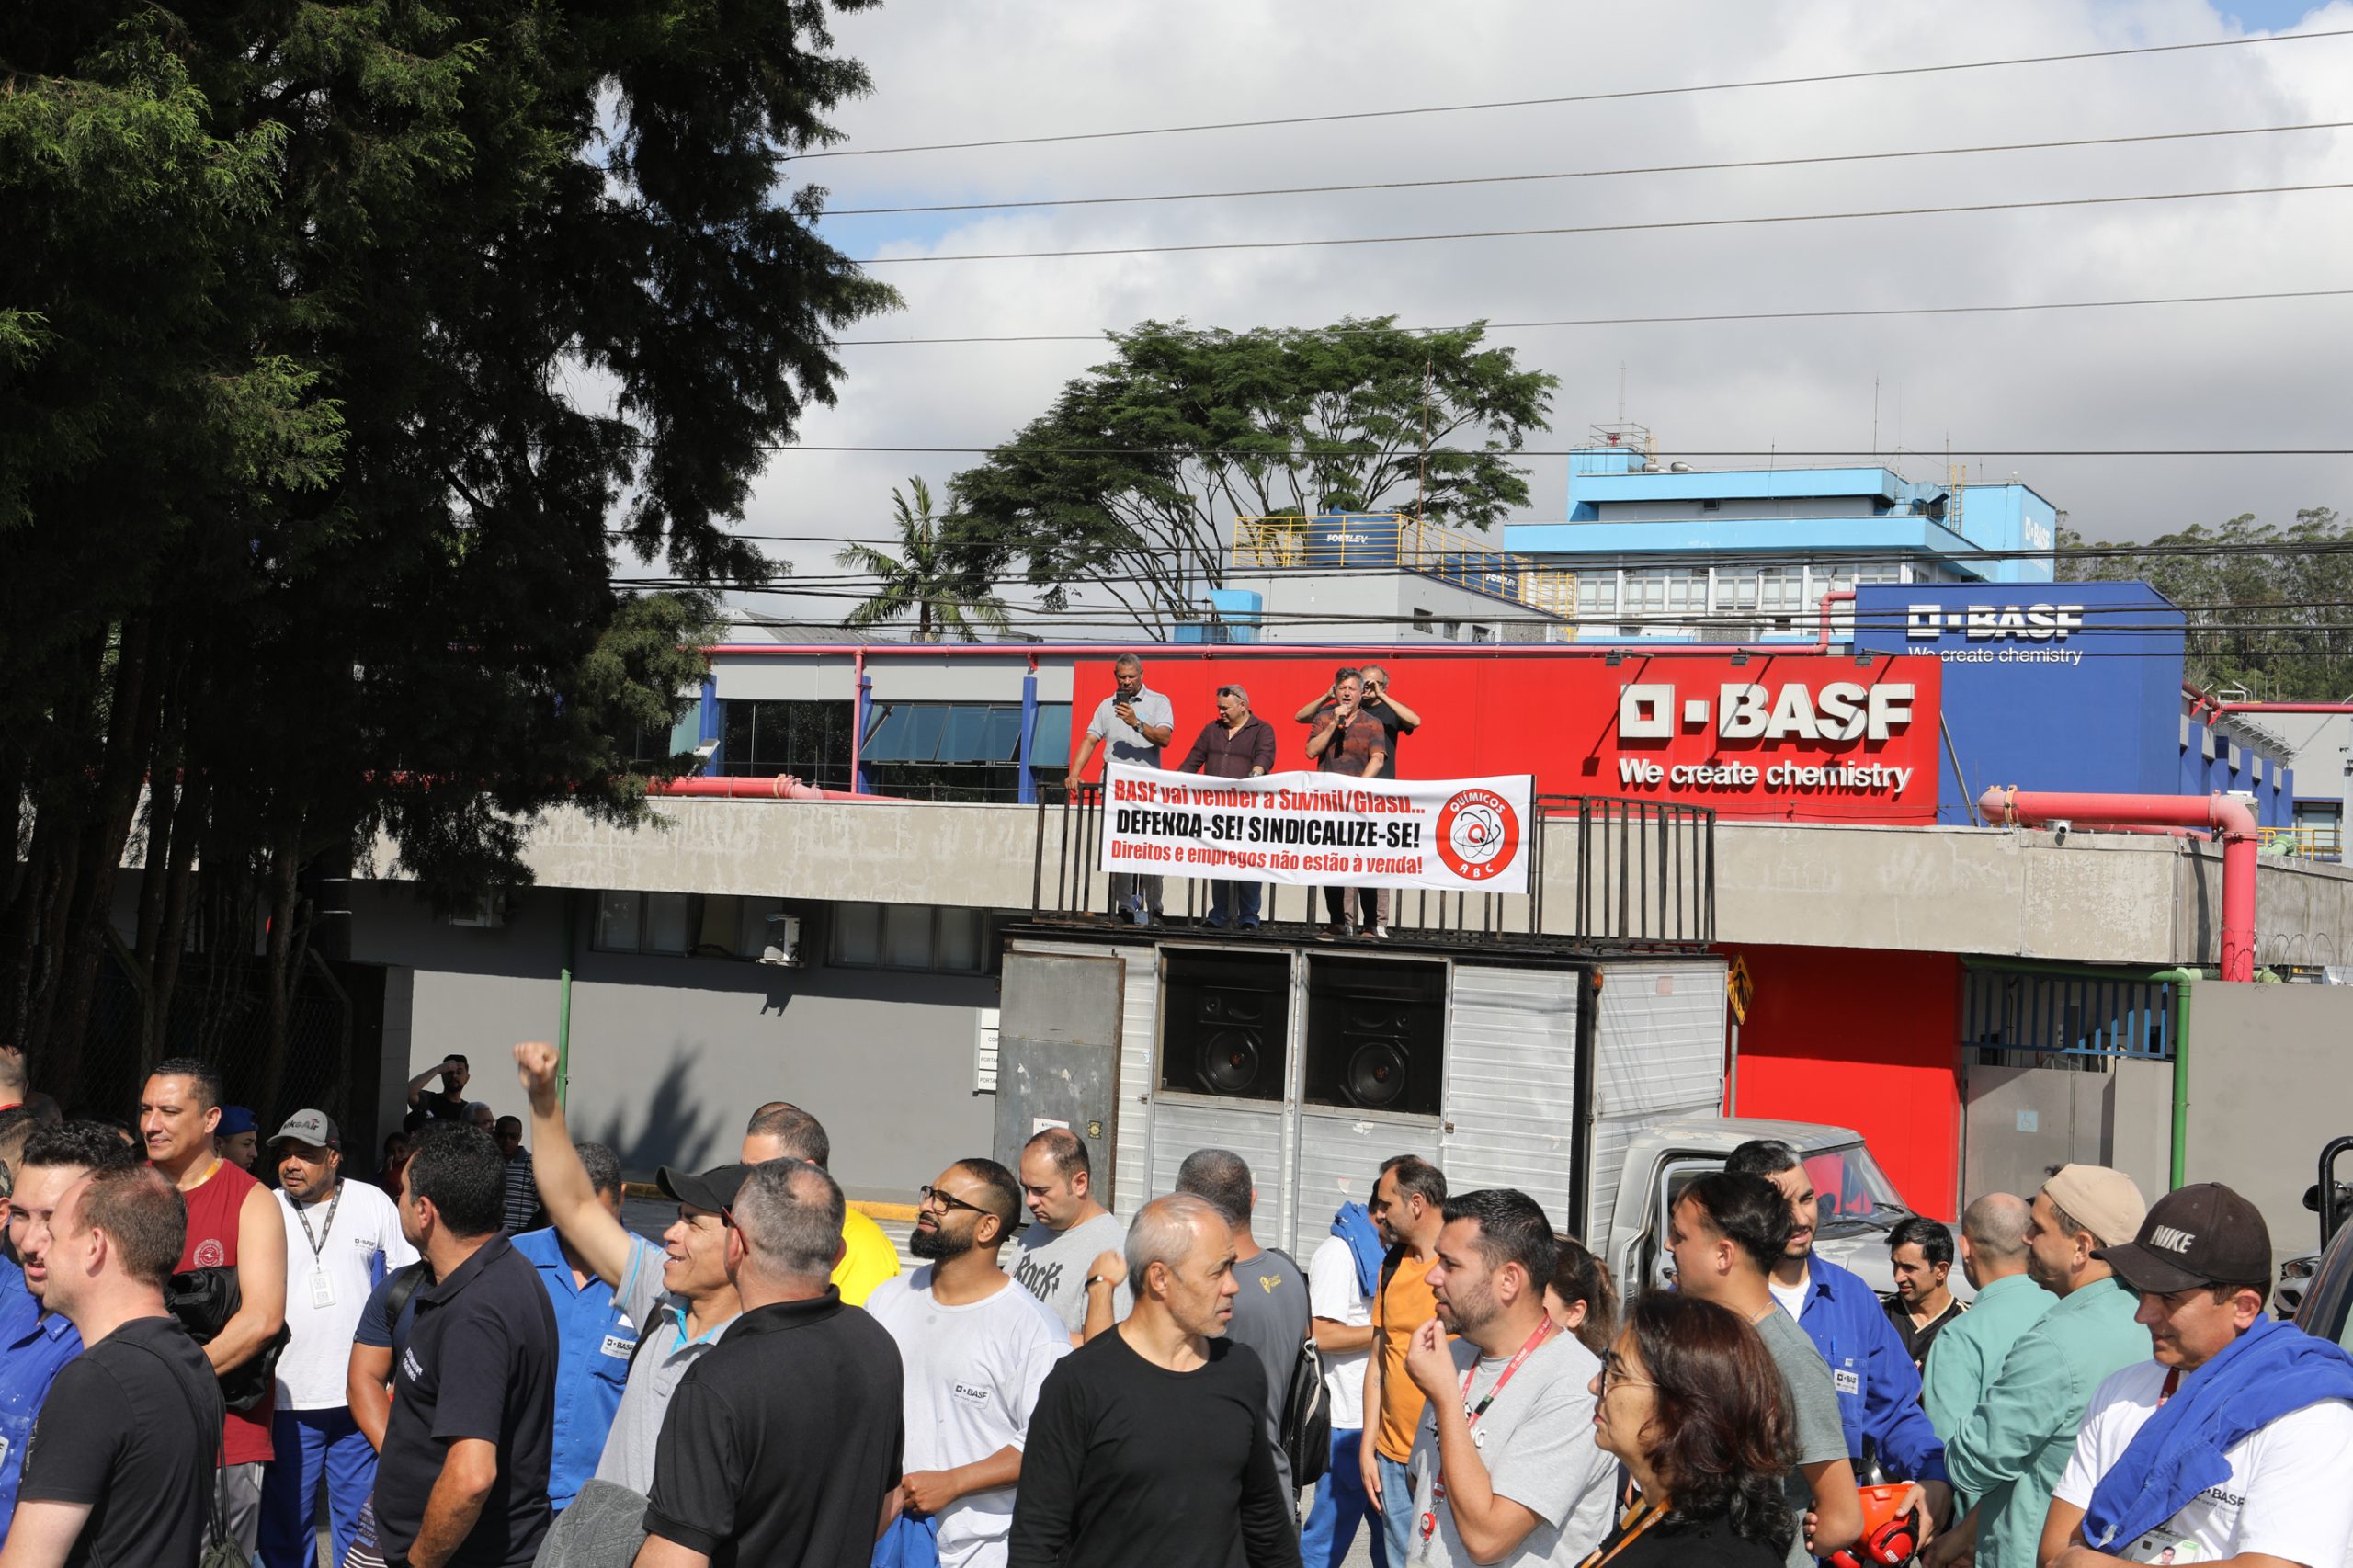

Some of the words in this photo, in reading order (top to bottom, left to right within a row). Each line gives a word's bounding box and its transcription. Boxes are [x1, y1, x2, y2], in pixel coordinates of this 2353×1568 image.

[1967, 603, 2084, 639] BASF
[1941, 648, 1994, 663] create
[1998, 647, 2083, 665] chemistry
[1719, 682, 1915, 741] BASF
[1619, 758, 1664, 784] We
[1670, 761, 1759, 786] create
[1766, 760, 1914, 792] chemistry
[1114, 779, 1157, 803] BASF
[1161, 784, 1188, 804] vai
[1191, 787, 1259, 809] vender
[1264, 791, 1275, 809] a
[1449, 790, 1506, 814] QUÍMICOS
[1116, 809, 1244, 841] DEFENDA-SE!
[1248, 816, 1421, 848] SINDICALIZE-SE!
[1111, 840, 1171, 861] Direitos
[1175, 846, 1184, 861] e
[1187, 847, 1267, 869] empregos
[1269, 850, 1299, 870] não
[1303, 852, 1348, 872] estão
[1353, 854, 1362, 872] à
[1366, 856, 1423, 874] venda!
[2149, 1224, 2196, 1254] NIKE
[1014, 1252, 1063, 1303] ROCK
[617, 1342, 634, 1351] BASF
[966, 1388, 988, 1399] BASF
[2211, 1488, 2245, 1507] BASF
